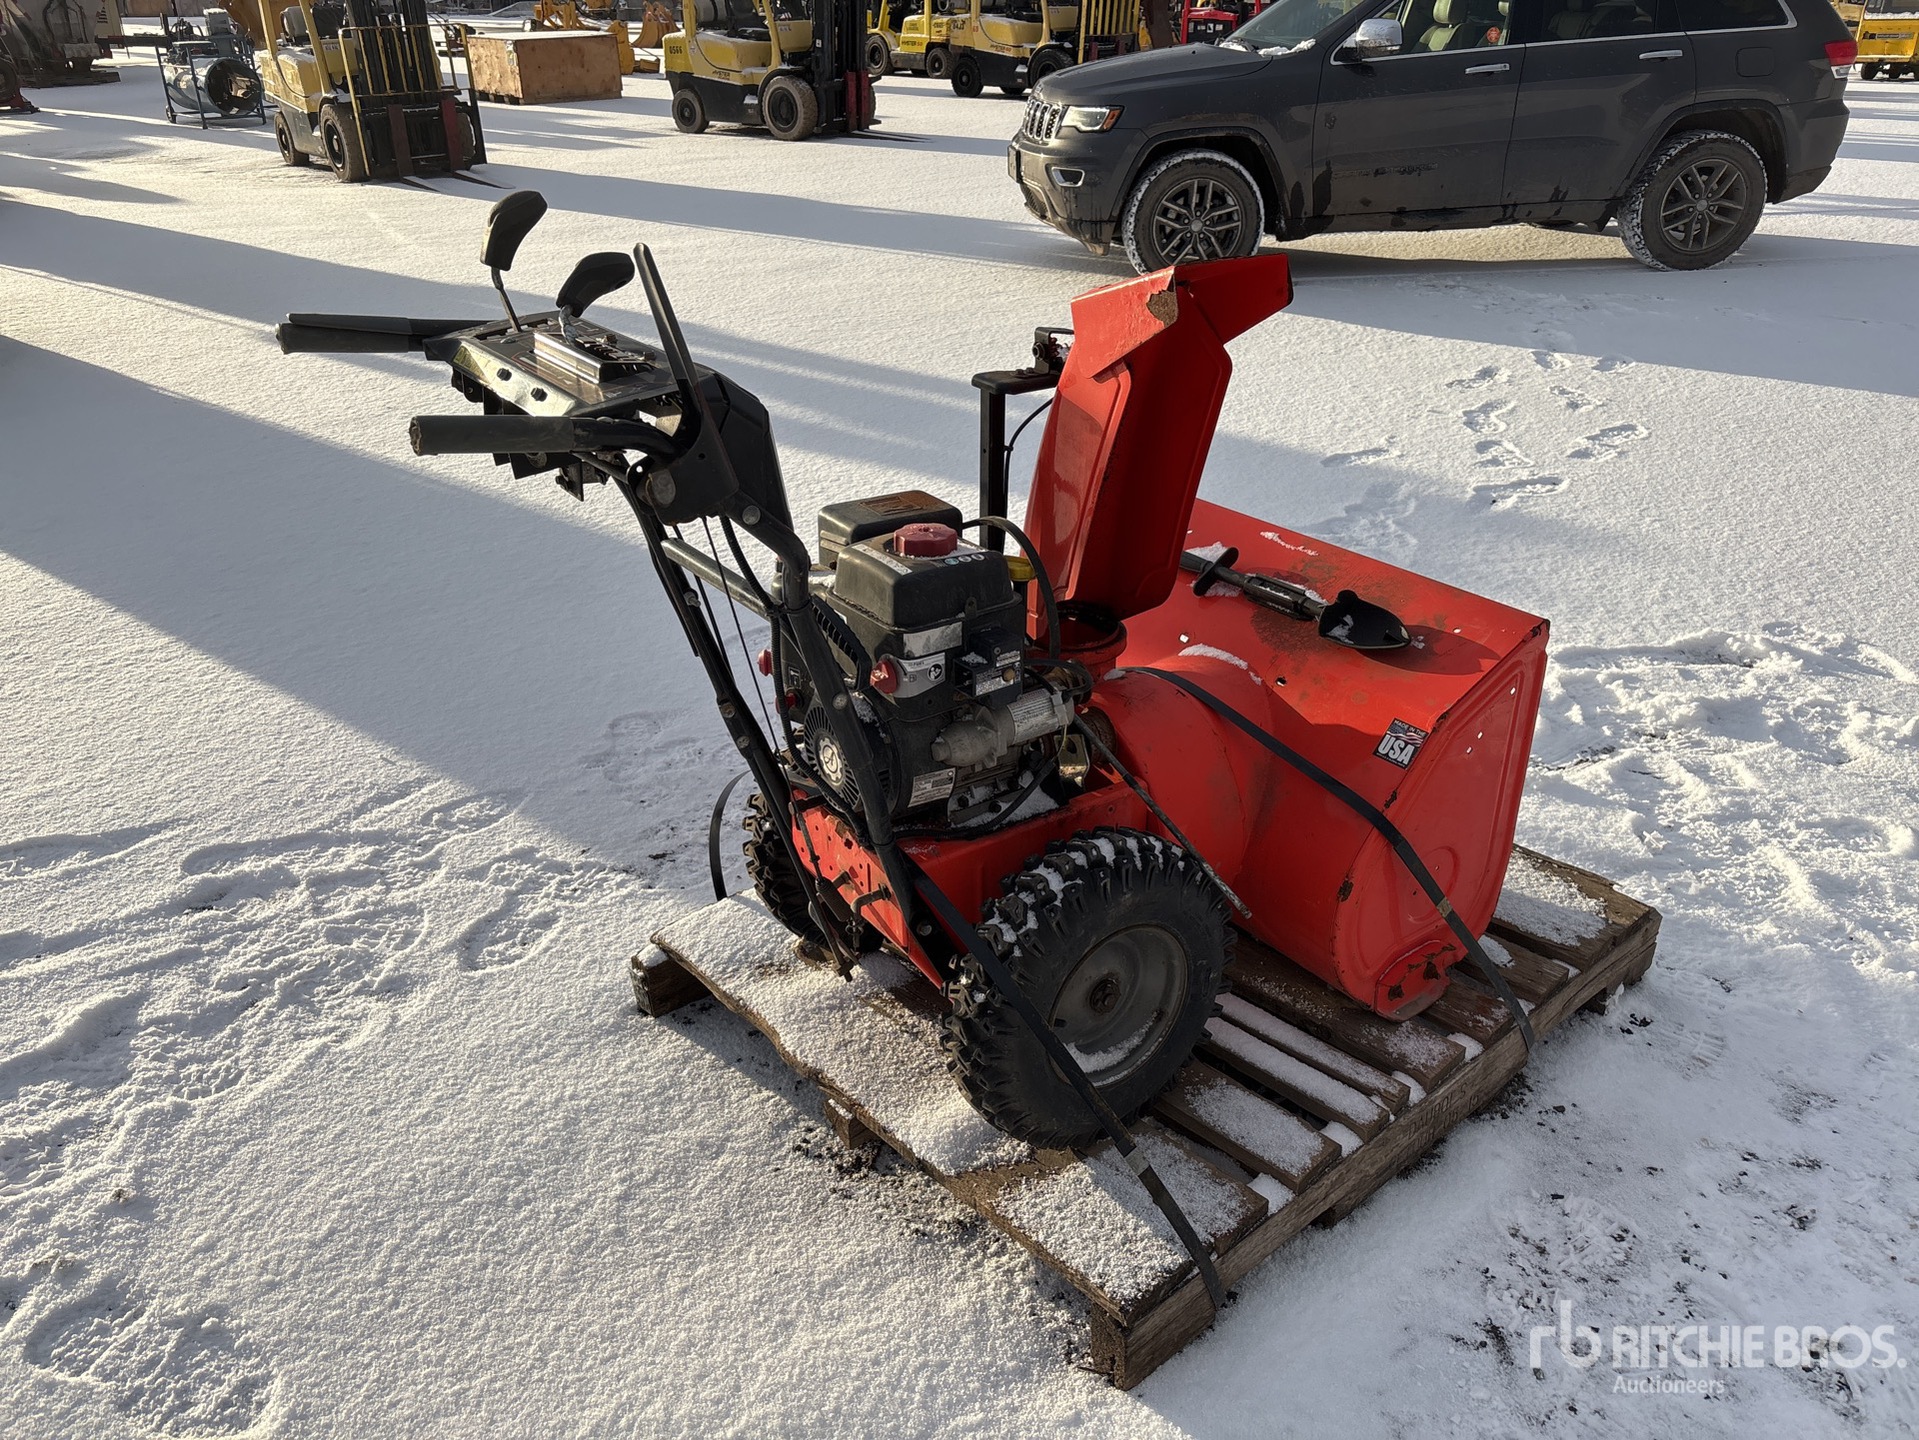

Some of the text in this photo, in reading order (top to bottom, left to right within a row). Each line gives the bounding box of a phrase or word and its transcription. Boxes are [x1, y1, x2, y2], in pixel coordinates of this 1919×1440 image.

[1394, 720, 1409, 728] MADE
[1415, 729, 1427, 737] THE
[1378, 734, 1415, 765] USA
